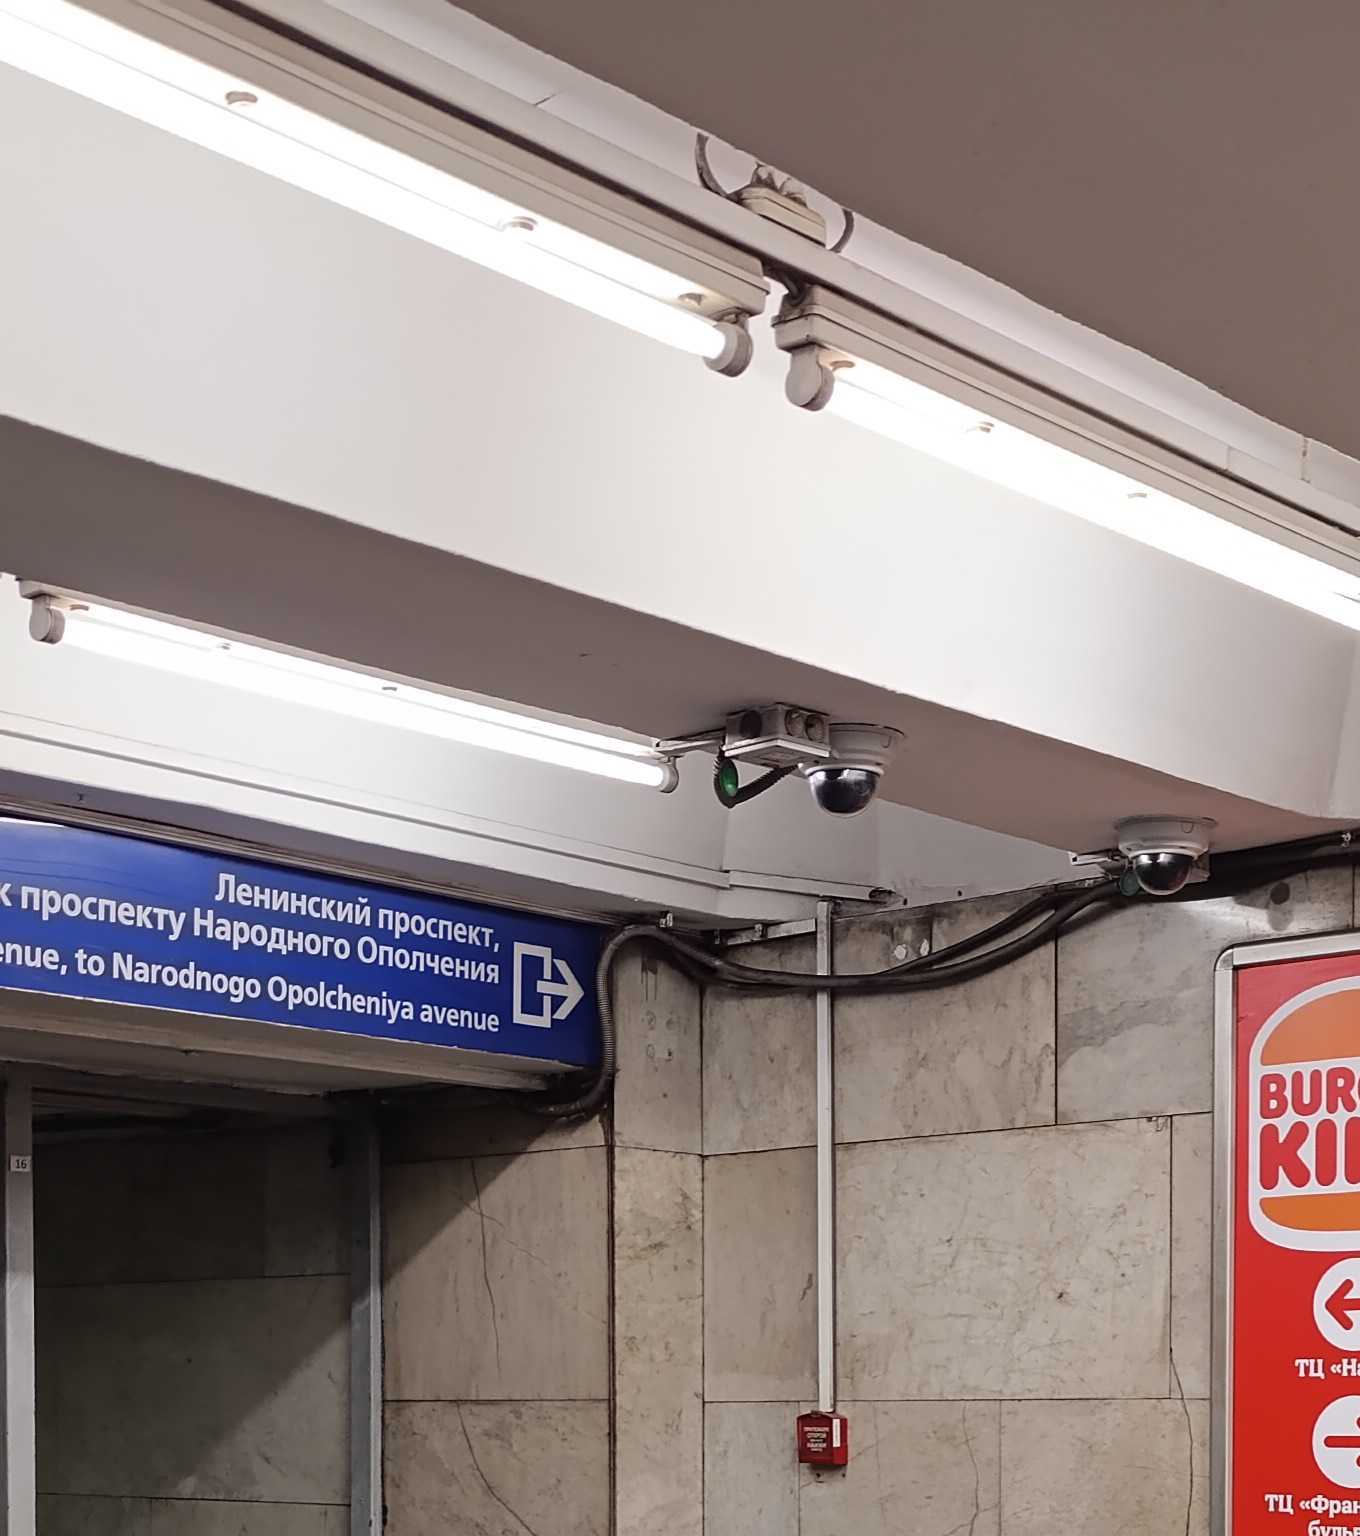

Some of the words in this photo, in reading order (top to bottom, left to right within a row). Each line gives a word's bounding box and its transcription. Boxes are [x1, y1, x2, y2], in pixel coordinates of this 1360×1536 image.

[20, 885, 186, 941] проспекту
[193, 907, 351, 960] Народного
[357, 936, 500, 984] Ополчения
[215, 872, 371, 927] Ленинский
[378, 908, 500, 953] проспект,
[74, 948, 105, 976] to
[112, 951, 262, 1003] Narodnogo
[267, 975, 414, 1024] Opolcheniya
[420, 1004, 500, 1033] avenue
[15, 1159, 27, 1169] 16
[1295, 1358, 1325, 1379] ТЦ
[1264, 1494, 1294, 1515] ТЦ
